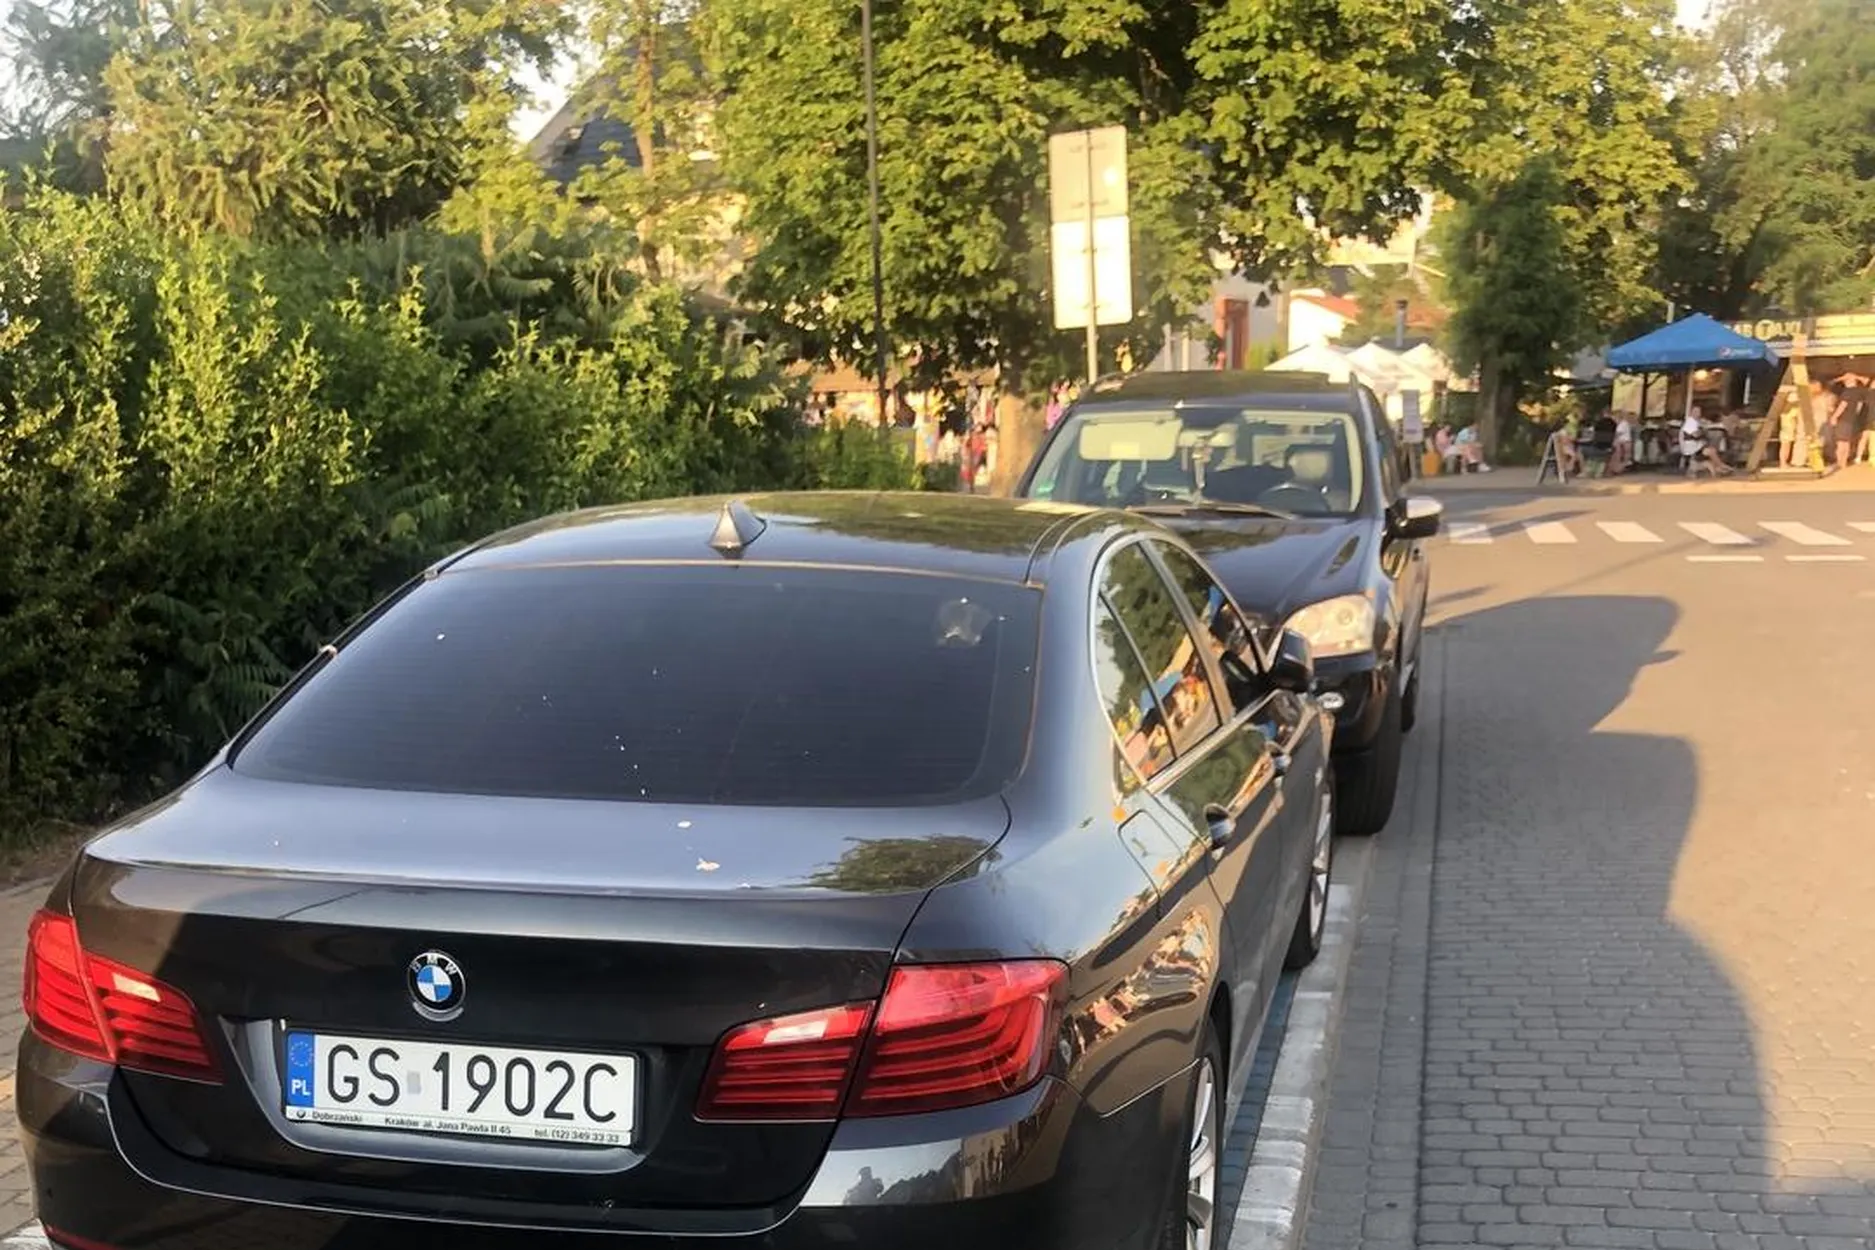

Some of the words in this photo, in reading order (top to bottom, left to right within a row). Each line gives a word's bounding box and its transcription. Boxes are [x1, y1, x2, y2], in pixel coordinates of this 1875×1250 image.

[409, 953, 458, 975] BMW
[291, 1079, 311, 1096] PL
[328, 1044, 400, 1106] GS
[433, 1052, 618, 1123] 1902C
[437, 1121, 459, 1131] Jana
